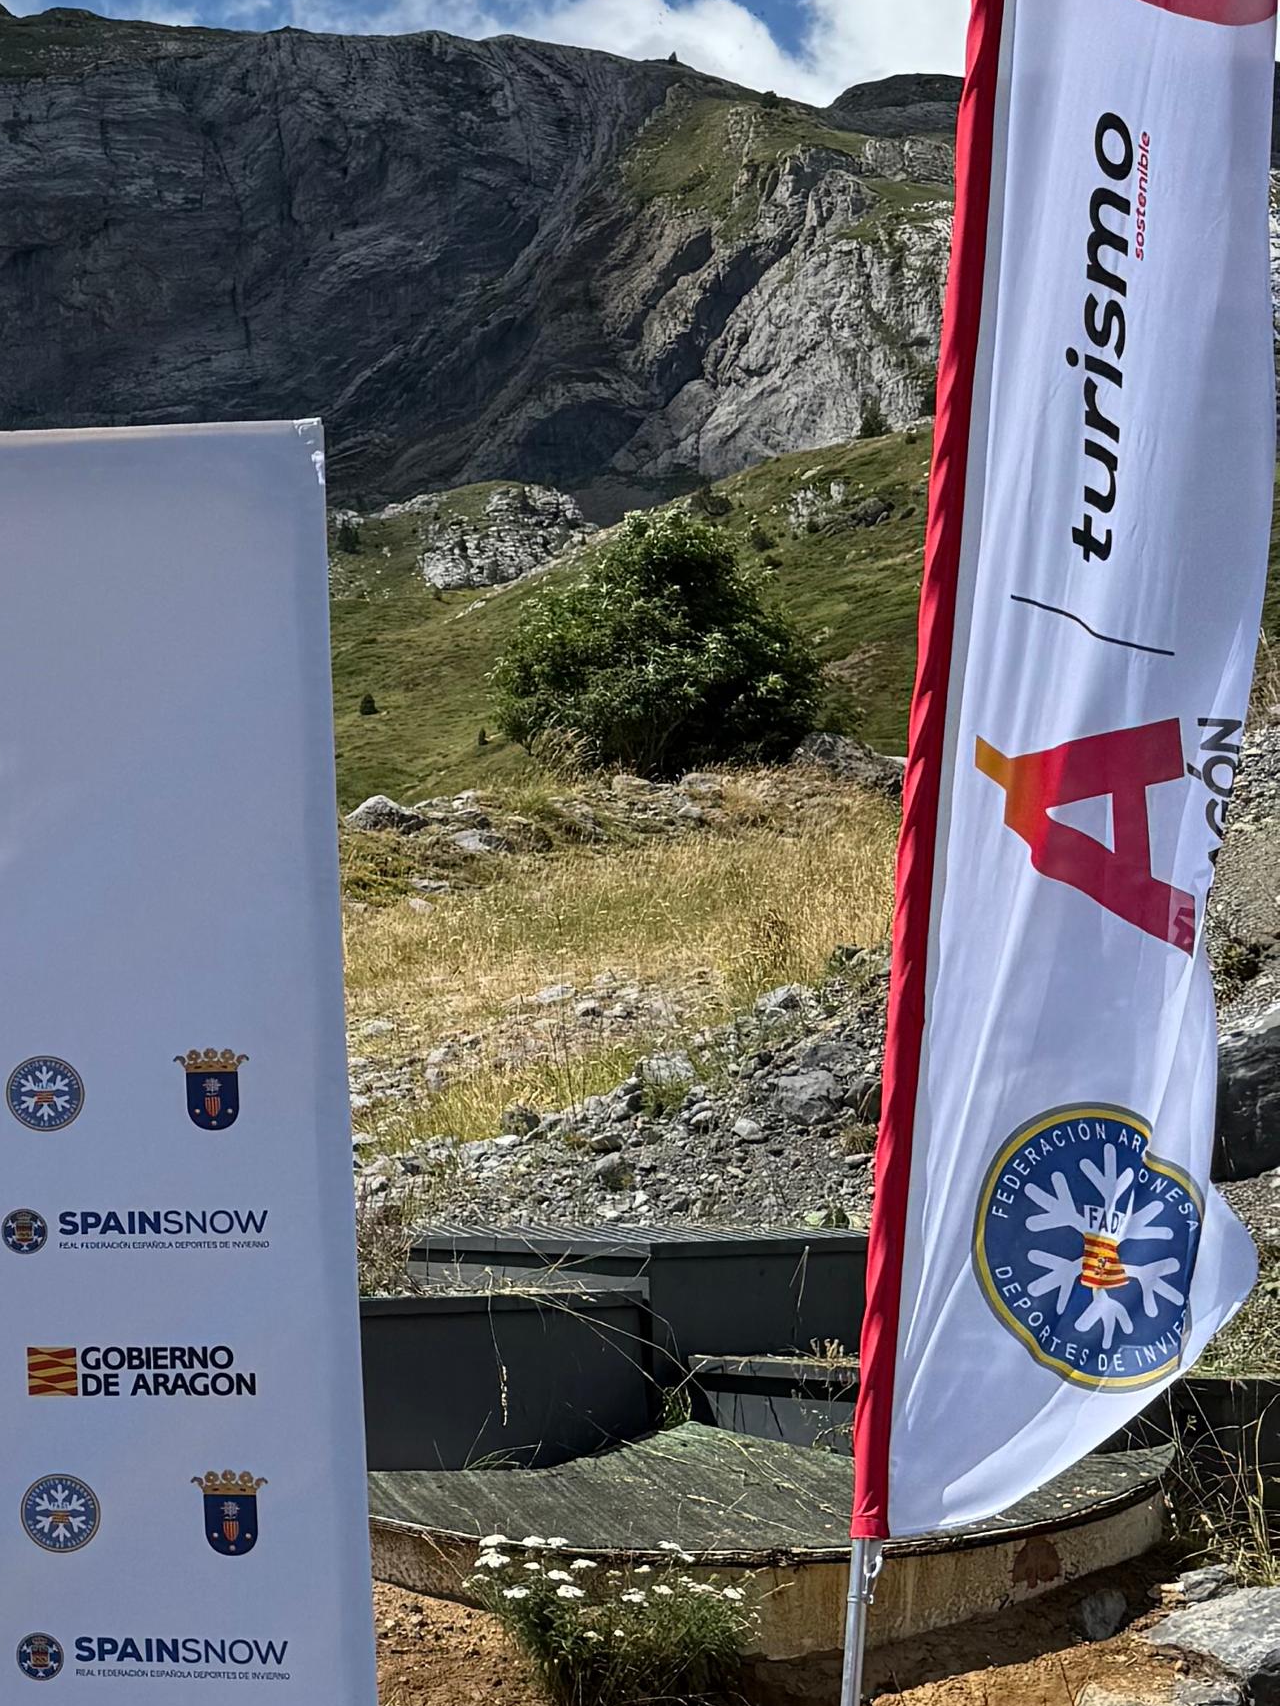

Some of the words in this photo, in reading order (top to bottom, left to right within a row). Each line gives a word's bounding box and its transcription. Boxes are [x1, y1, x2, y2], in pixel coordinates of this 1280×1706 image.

[1134, 129, 1151, 261] sostenible
[1073, 110, 1135, 563] turismo
[992, 1119, 1107, 1219] FEDERACIÓN
[59, 1210, 268, 1235] SPAINSNOW
[995, 1267, 1089, 1366] DEPORTES
[1098, 1353, 1125, 1372] DE
[81, 1346, 233, 1369] GOBIERNO
[81, 1373, 120, 1396] DE
[130, 1373, 257, 1397] ARAGON
[75, 1636, 288, 1665] SPAINSNOW
